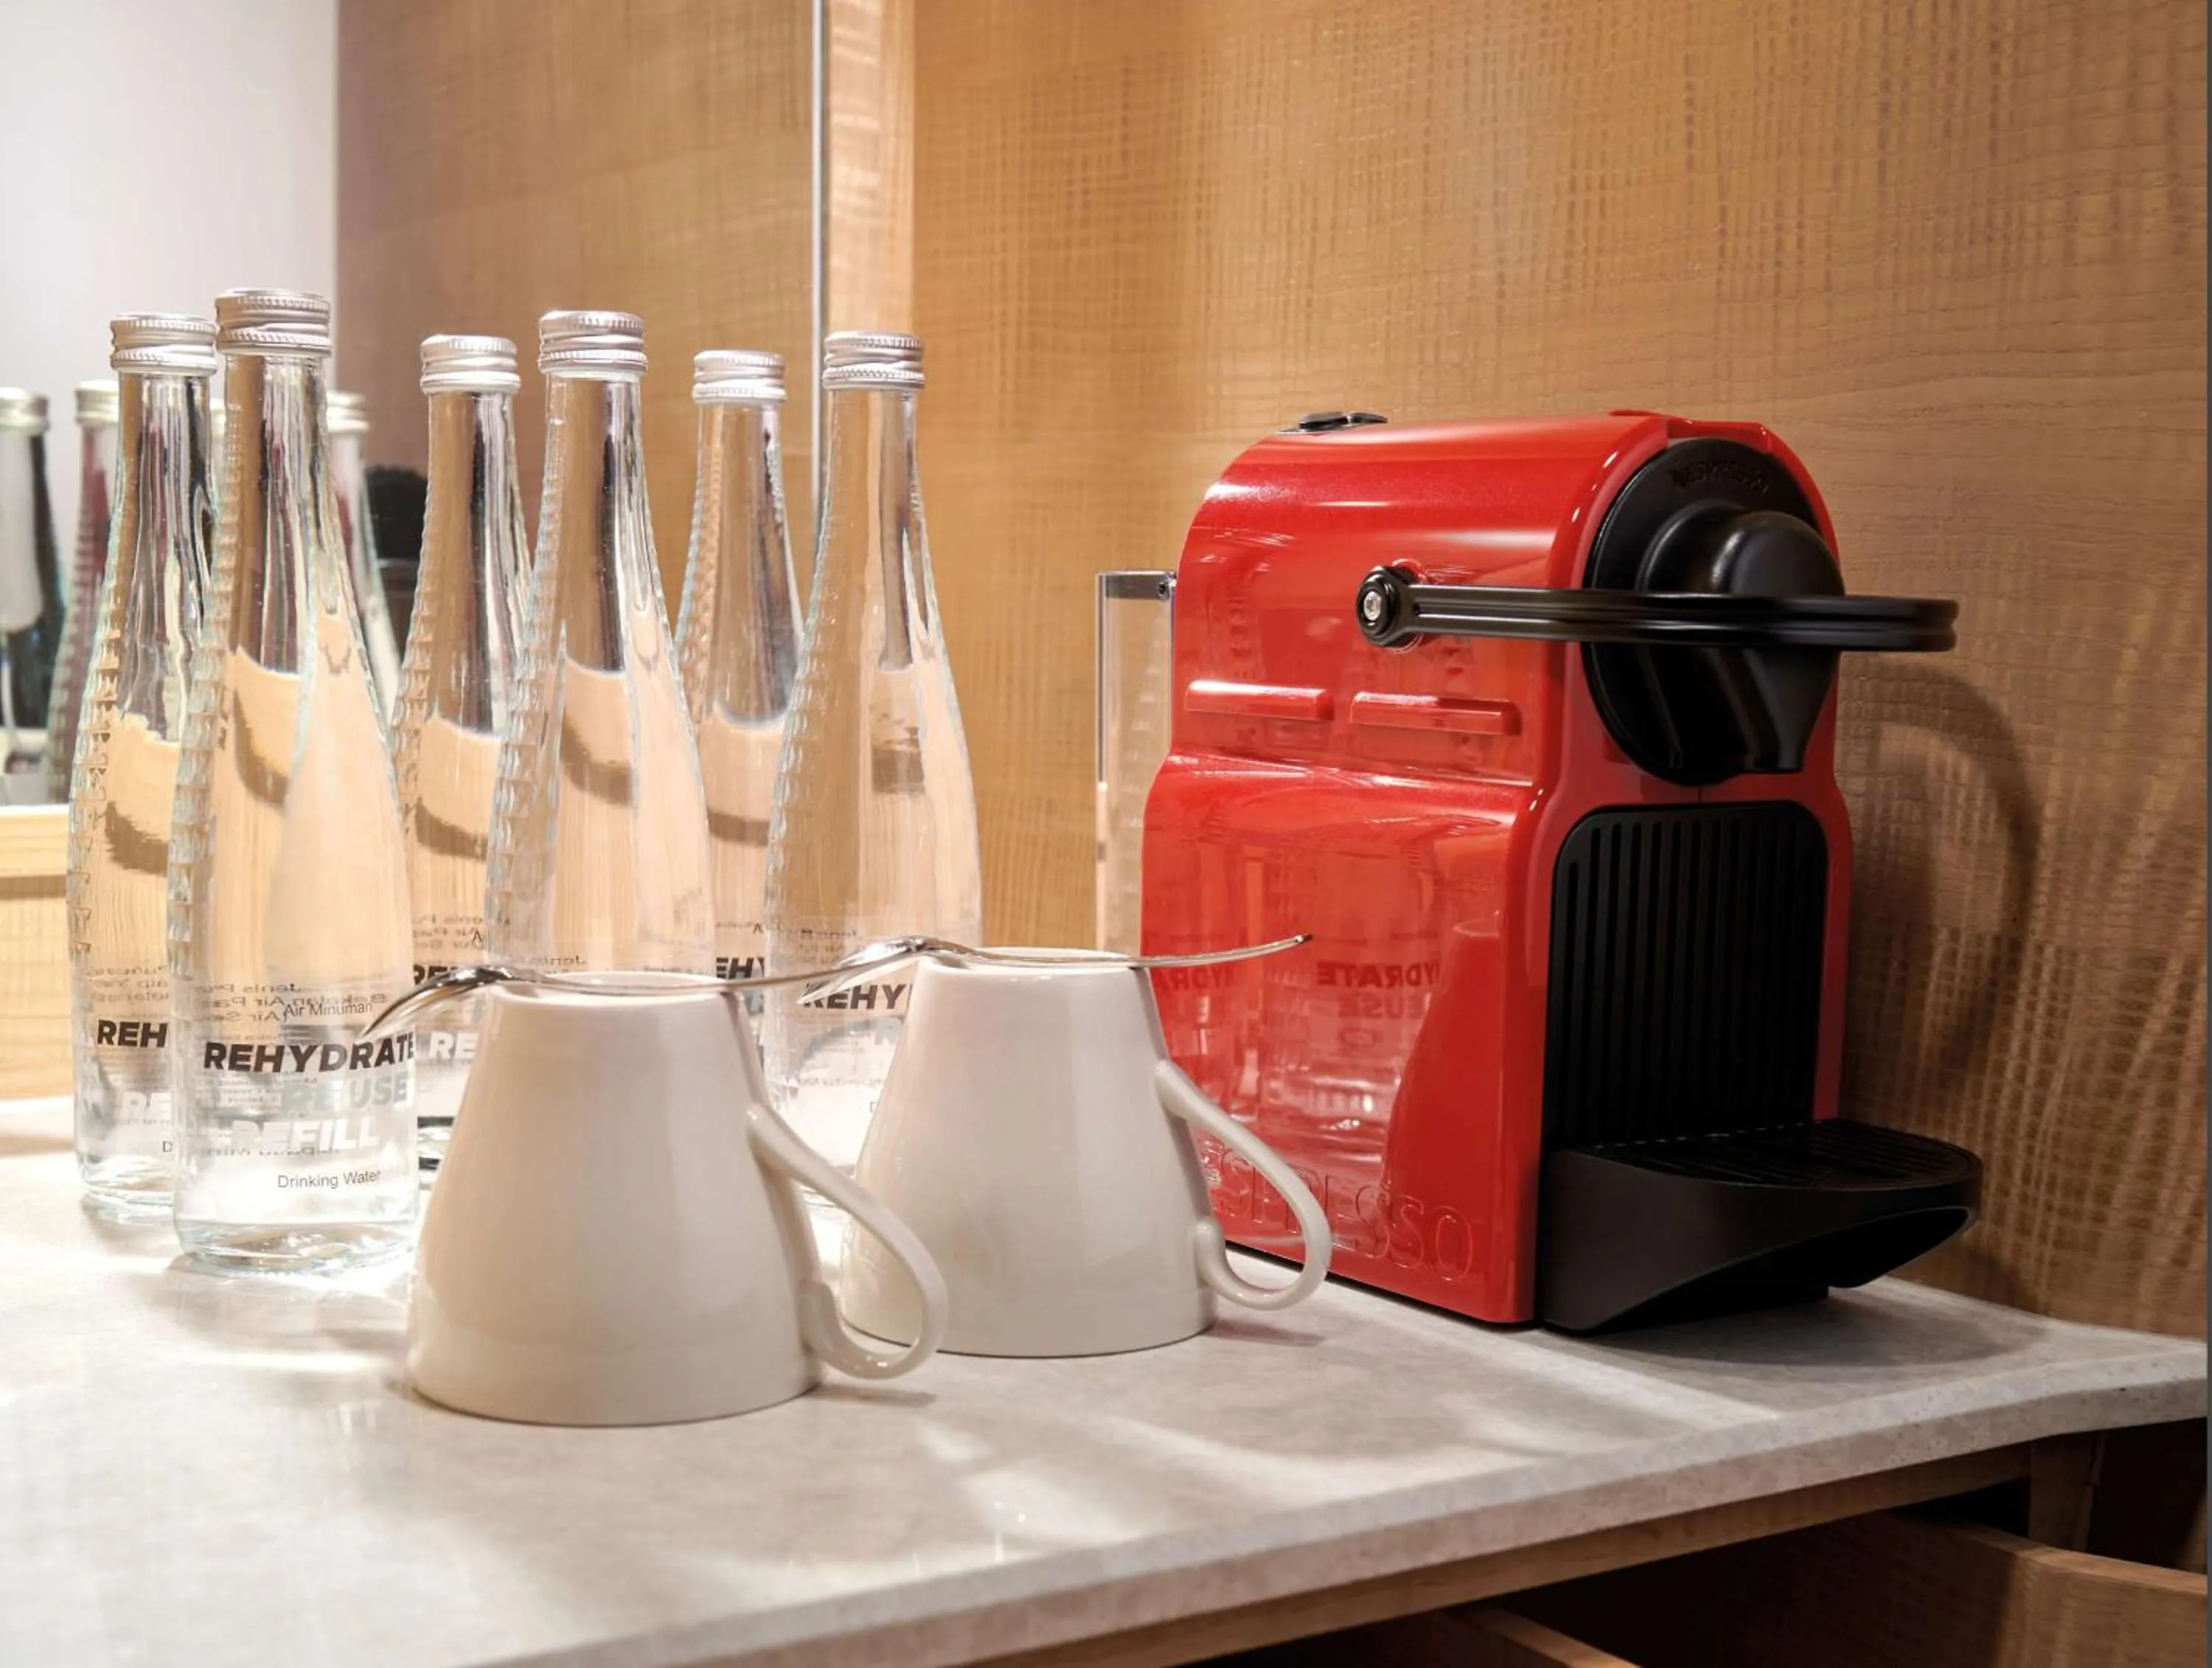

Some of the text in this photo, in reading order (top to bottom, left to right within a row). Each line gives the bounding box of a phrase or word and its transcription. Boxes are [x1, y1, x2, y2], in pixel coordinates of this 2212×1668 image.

[283, 1000, 373, 1017] Air Minuman
[204, 1032, 414, 1072] REHYDRATE
[277, 1170, 381, 1189] Drinking Water
